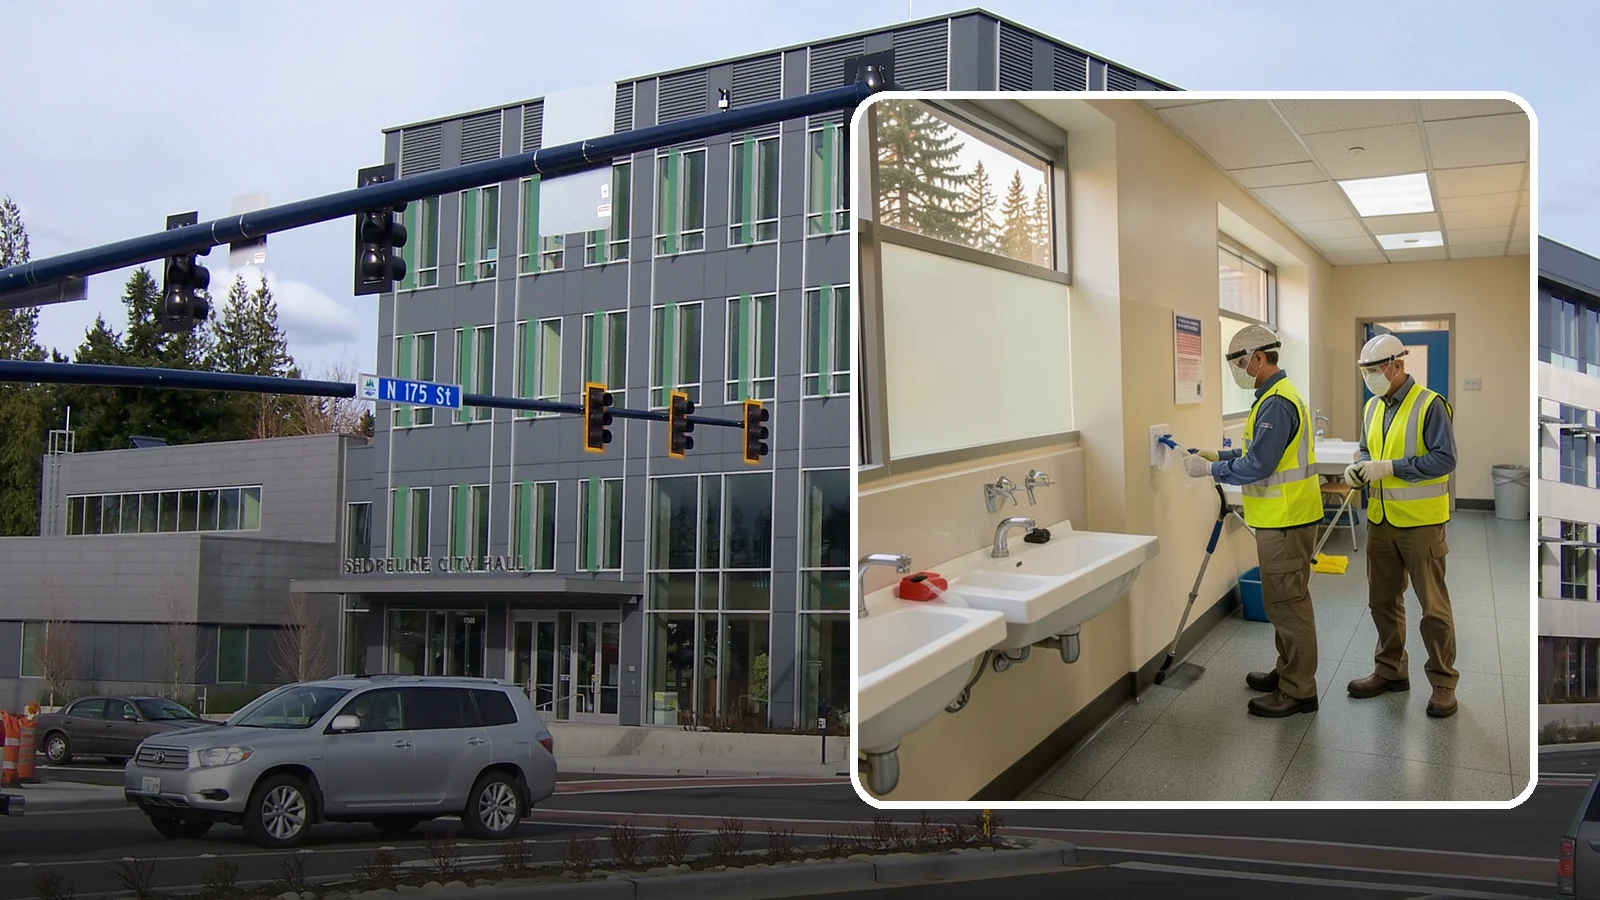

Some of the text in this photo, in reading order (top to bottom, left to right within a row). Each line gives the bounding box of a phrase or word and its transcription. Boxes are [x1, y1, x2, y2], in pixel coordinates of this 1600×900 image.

[387, 380, 451, 406] N 175 St
[344, 555, 525, 574] SHORELINE CITY HALL
